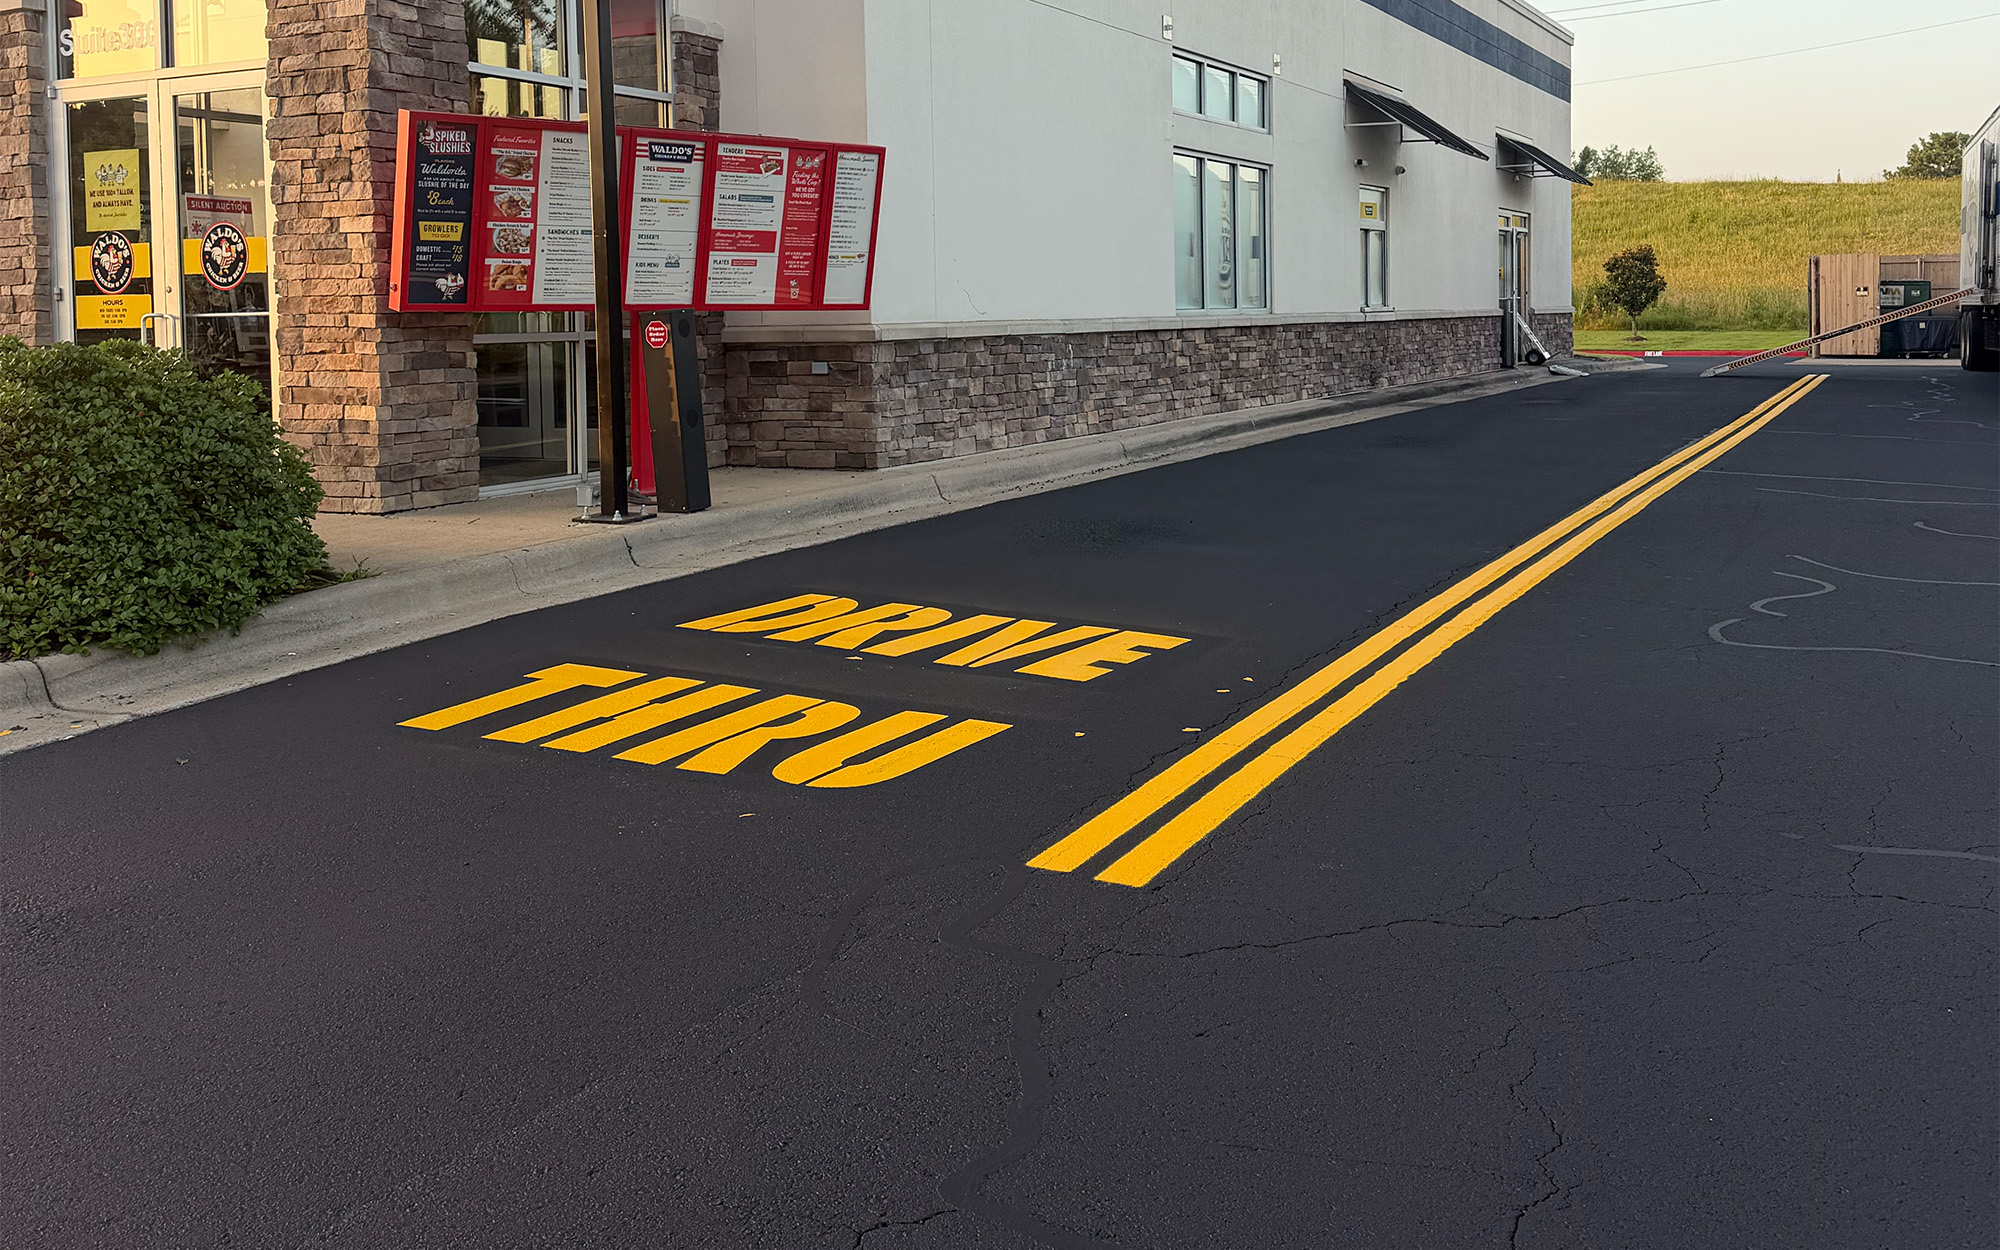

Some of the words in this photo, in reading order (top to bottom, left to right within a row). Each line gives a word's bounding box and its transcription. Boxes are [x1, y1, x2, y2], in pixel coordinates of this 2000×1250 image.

[436, 131, 466, 142] SPIKED
[430, 142, 470, 153] SLUSHIES
[652, 145, 692, 155] WALDO'S
[420, 163, 468, 176] Waldorita
[792, 171, 810, 180] Feeding
[427, 190, 440, 205] $8
[191, 200, 214, 209] SILENT
[216, 202, 248, 211] AUCTION
[424, 224, 458, 233] GROWLERS
[204, 227, 244, 252] WALDO'S
[93, 234, 130, 259] WALDO'S
[452, 245, 463, 254] $15
[452, 254, 463, 262] $18
[95, 268, 115, 289] CHICKEN
[120, 268, 129, 284] BEER
[206, 262, 227, 283] CHICKEN
[233, 262, 244, 279] BEER
[675, 593, 1193, 682] DRIVE
[396, 662, 1014, 788] THRU
